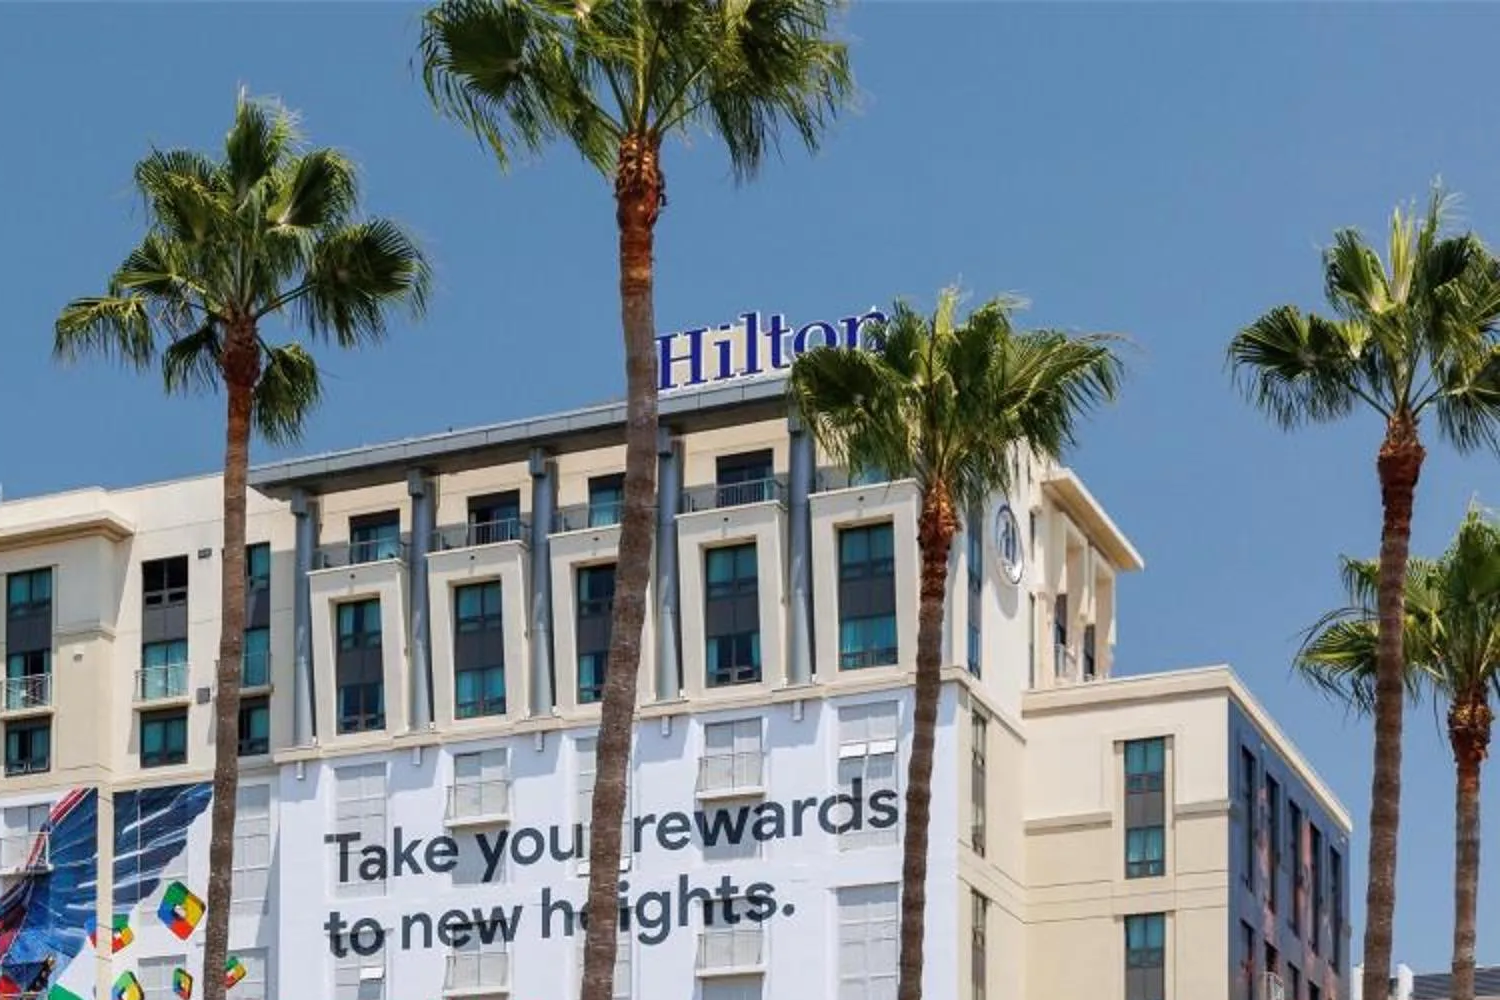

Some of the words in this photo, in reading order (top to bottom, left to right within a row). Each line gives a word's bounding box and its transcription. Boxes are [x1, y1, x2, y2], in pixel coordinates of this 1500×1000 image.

[656, 310, 888, 391] Hilton
[324, 826, 459, 883] Take
[475, 822, 584, 883] you
[633, 777, 899, 853] rewards
[324, 911, 386, 958] to
[401, 905, 523, 950] new
